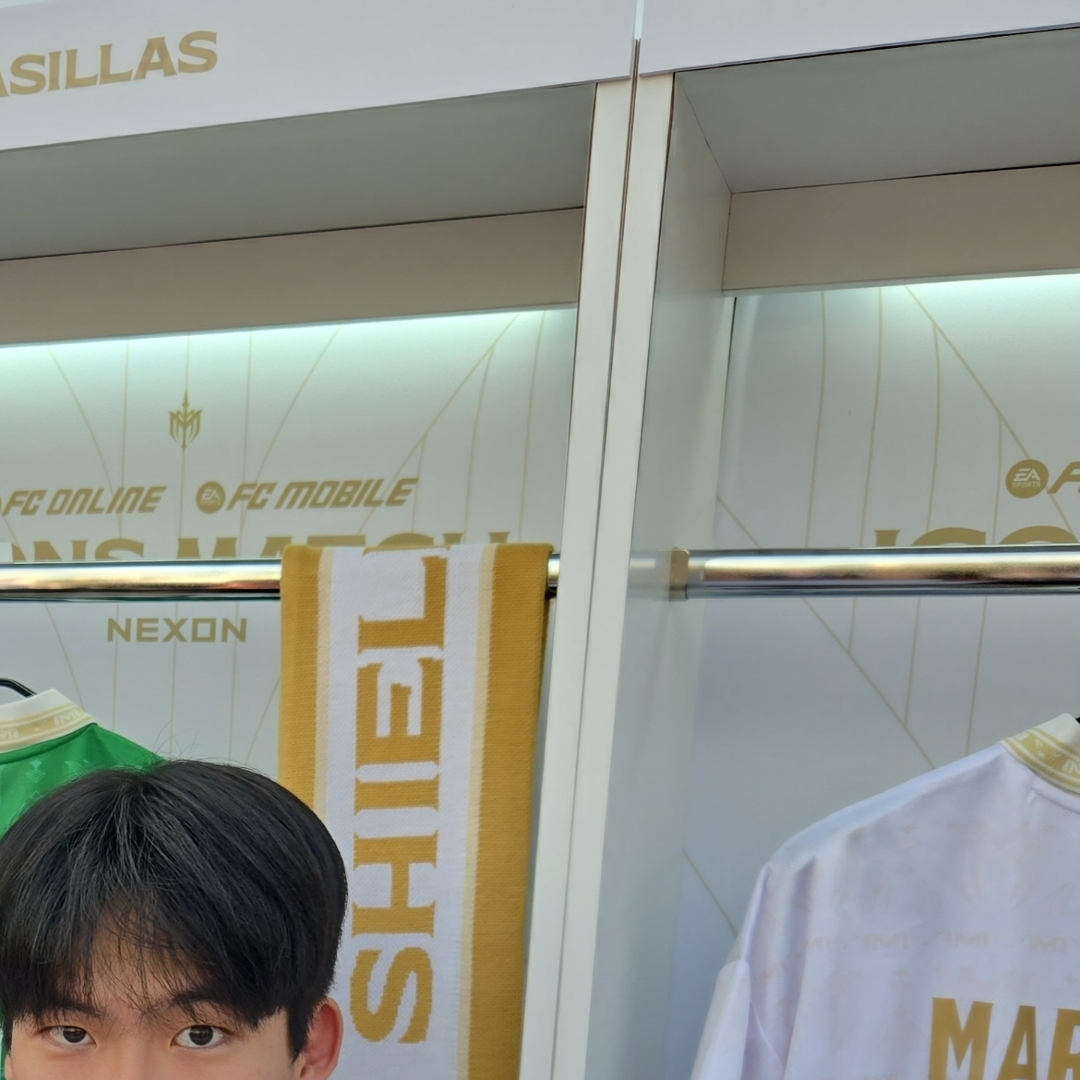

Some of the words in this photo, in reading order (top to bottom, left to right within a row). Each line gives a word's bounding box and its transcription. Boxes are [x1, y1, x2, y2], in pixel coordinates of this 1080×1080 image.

[1013, 467, 1041, 481] EA
[1047, 461, 1080, 494] F
[1, 489, 48, 517] FC
[46, 485, 167, 515] ONLINE
[226, 481, 278, 511] FC
[274, 477, 419, 510] MOBILE
[107, 617, 247, 643] NEXON
[350, 547, 449, 1044] SHIEL
